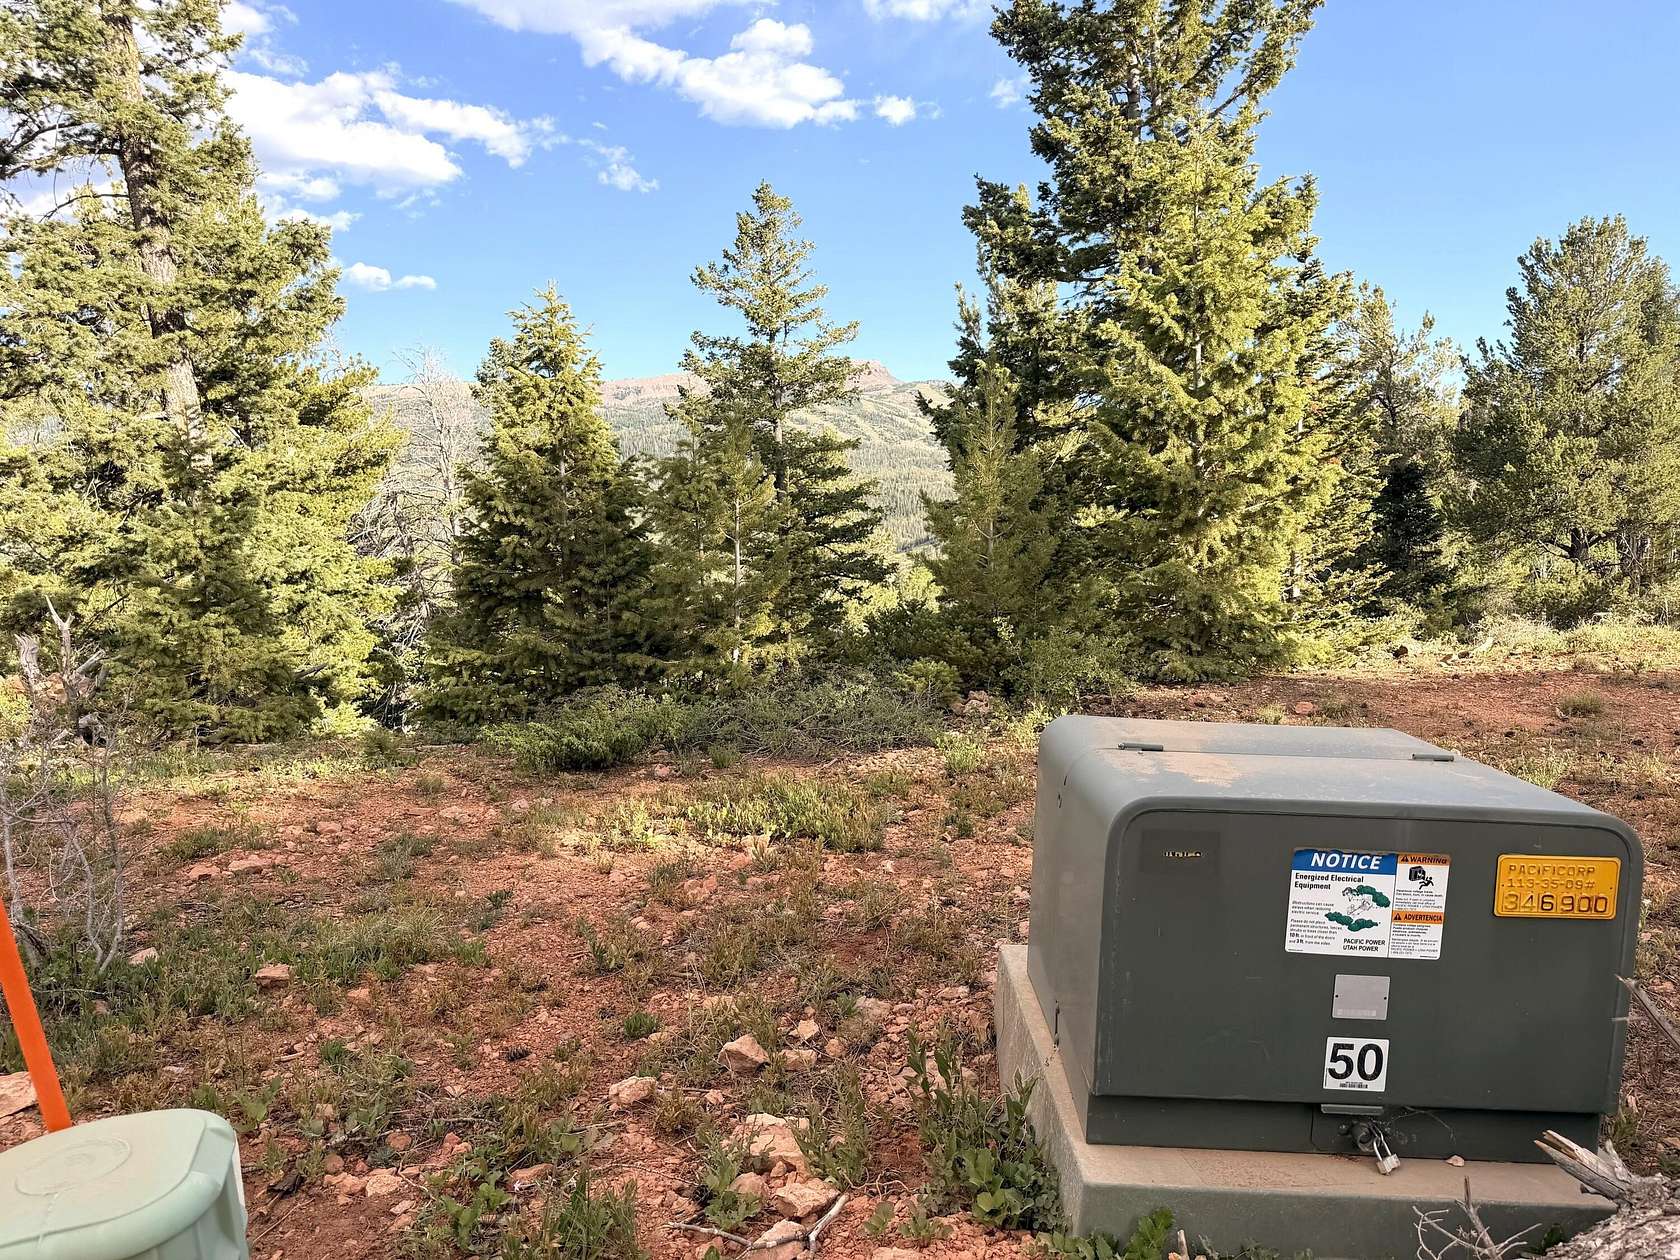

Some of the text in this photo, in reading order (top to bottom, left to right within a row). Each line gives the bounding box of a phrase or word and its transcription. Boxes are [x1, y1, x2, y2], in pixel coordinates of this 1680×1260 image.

[1311, 852, 1383, 870] NOTICE
[1410, 856, 1448, 865] WARNING
[1508, 864, 1596, 877] PACIFICORP
[1295, 873, 1364, 883] Energized Electrical
[1294, 881, 1331, 890] Equipment
[1503, 893, 1608, 913] 346900
[1404, 914, 1442, 922] ADVERTENCIA
[1327, 1043, 1384, 1081] 50
